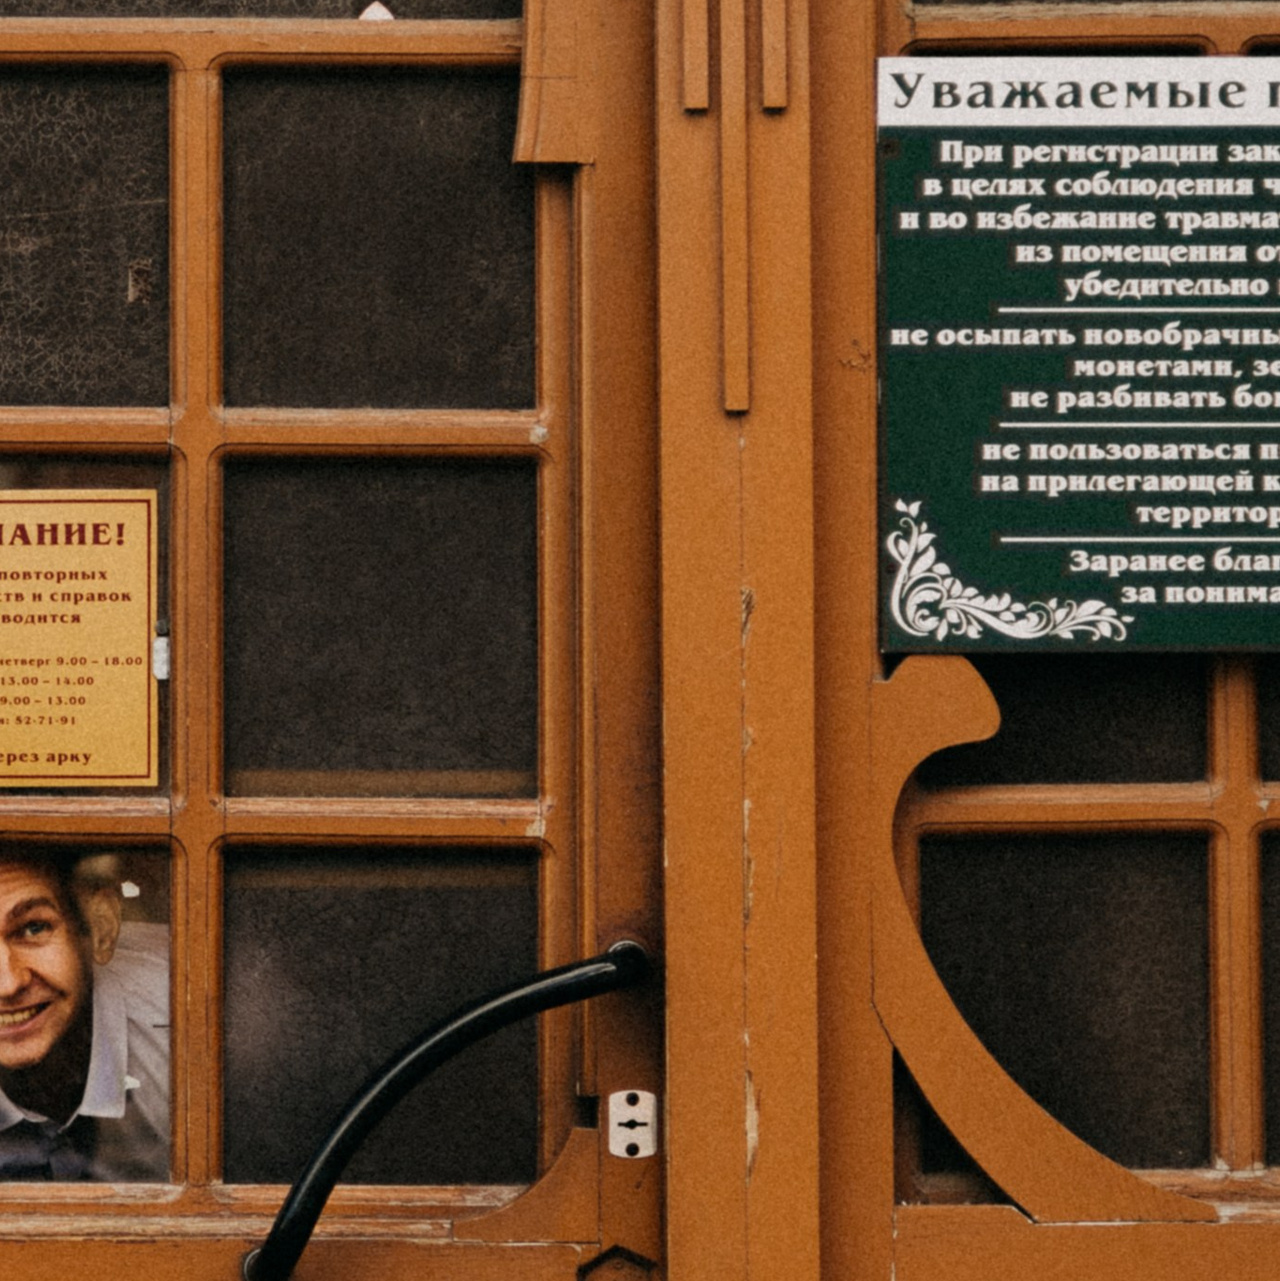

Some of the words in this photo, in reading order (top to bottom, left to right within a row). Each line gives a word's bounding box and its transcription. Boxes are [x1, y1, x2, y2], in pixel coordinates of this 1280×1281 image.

[891, 73, 1246, 109] Уважаемые
[940, 140, 1003, 169] При
[1013, 144, 1219, 169] регистрации
[923, 178, 943, 196] в
[951, 178, 1046, 200] целях
[1054, 171, 1254, 200] соблюдения
[900, 212, 919, 230] и
[929, 211, 968, 230] во
[976, 203, 1156, 231] избежание
[1164, 211, 1280, 236] травма
[1016, 244, 1054, 263] из
[1061, 244, 1247, 266] помещения
[1255, 244, 1280, 263] о
[1064, 270, 1270, 302] убедительно
[891, 328, 929, 346] не
[936, 328, 1076, 346] осыпать
[1074, 359, 1243, 378] монетами,
[1010, 391, 1049, 408] не
[1057, 383, 1227, 414] разбивать
[982, 443, 1021, 461] не
[1029, 443, 1251, 461] пользоваться
[981, 475, 1019, 492] на
[1027, 470, 1254, 498] прилегающей
[1069, 549, 1205, 578] Заранее
[31, 592, 43, 602] и
[49, 592, 132, 606] справок
[1121, 586, 1157, 604] за
[55, 656, 88, 667] 9.00
[104, 656, 143, 666] 18.00
[0, 696, 31, 706] 9.00
[45, 752, 91, 766] арку
